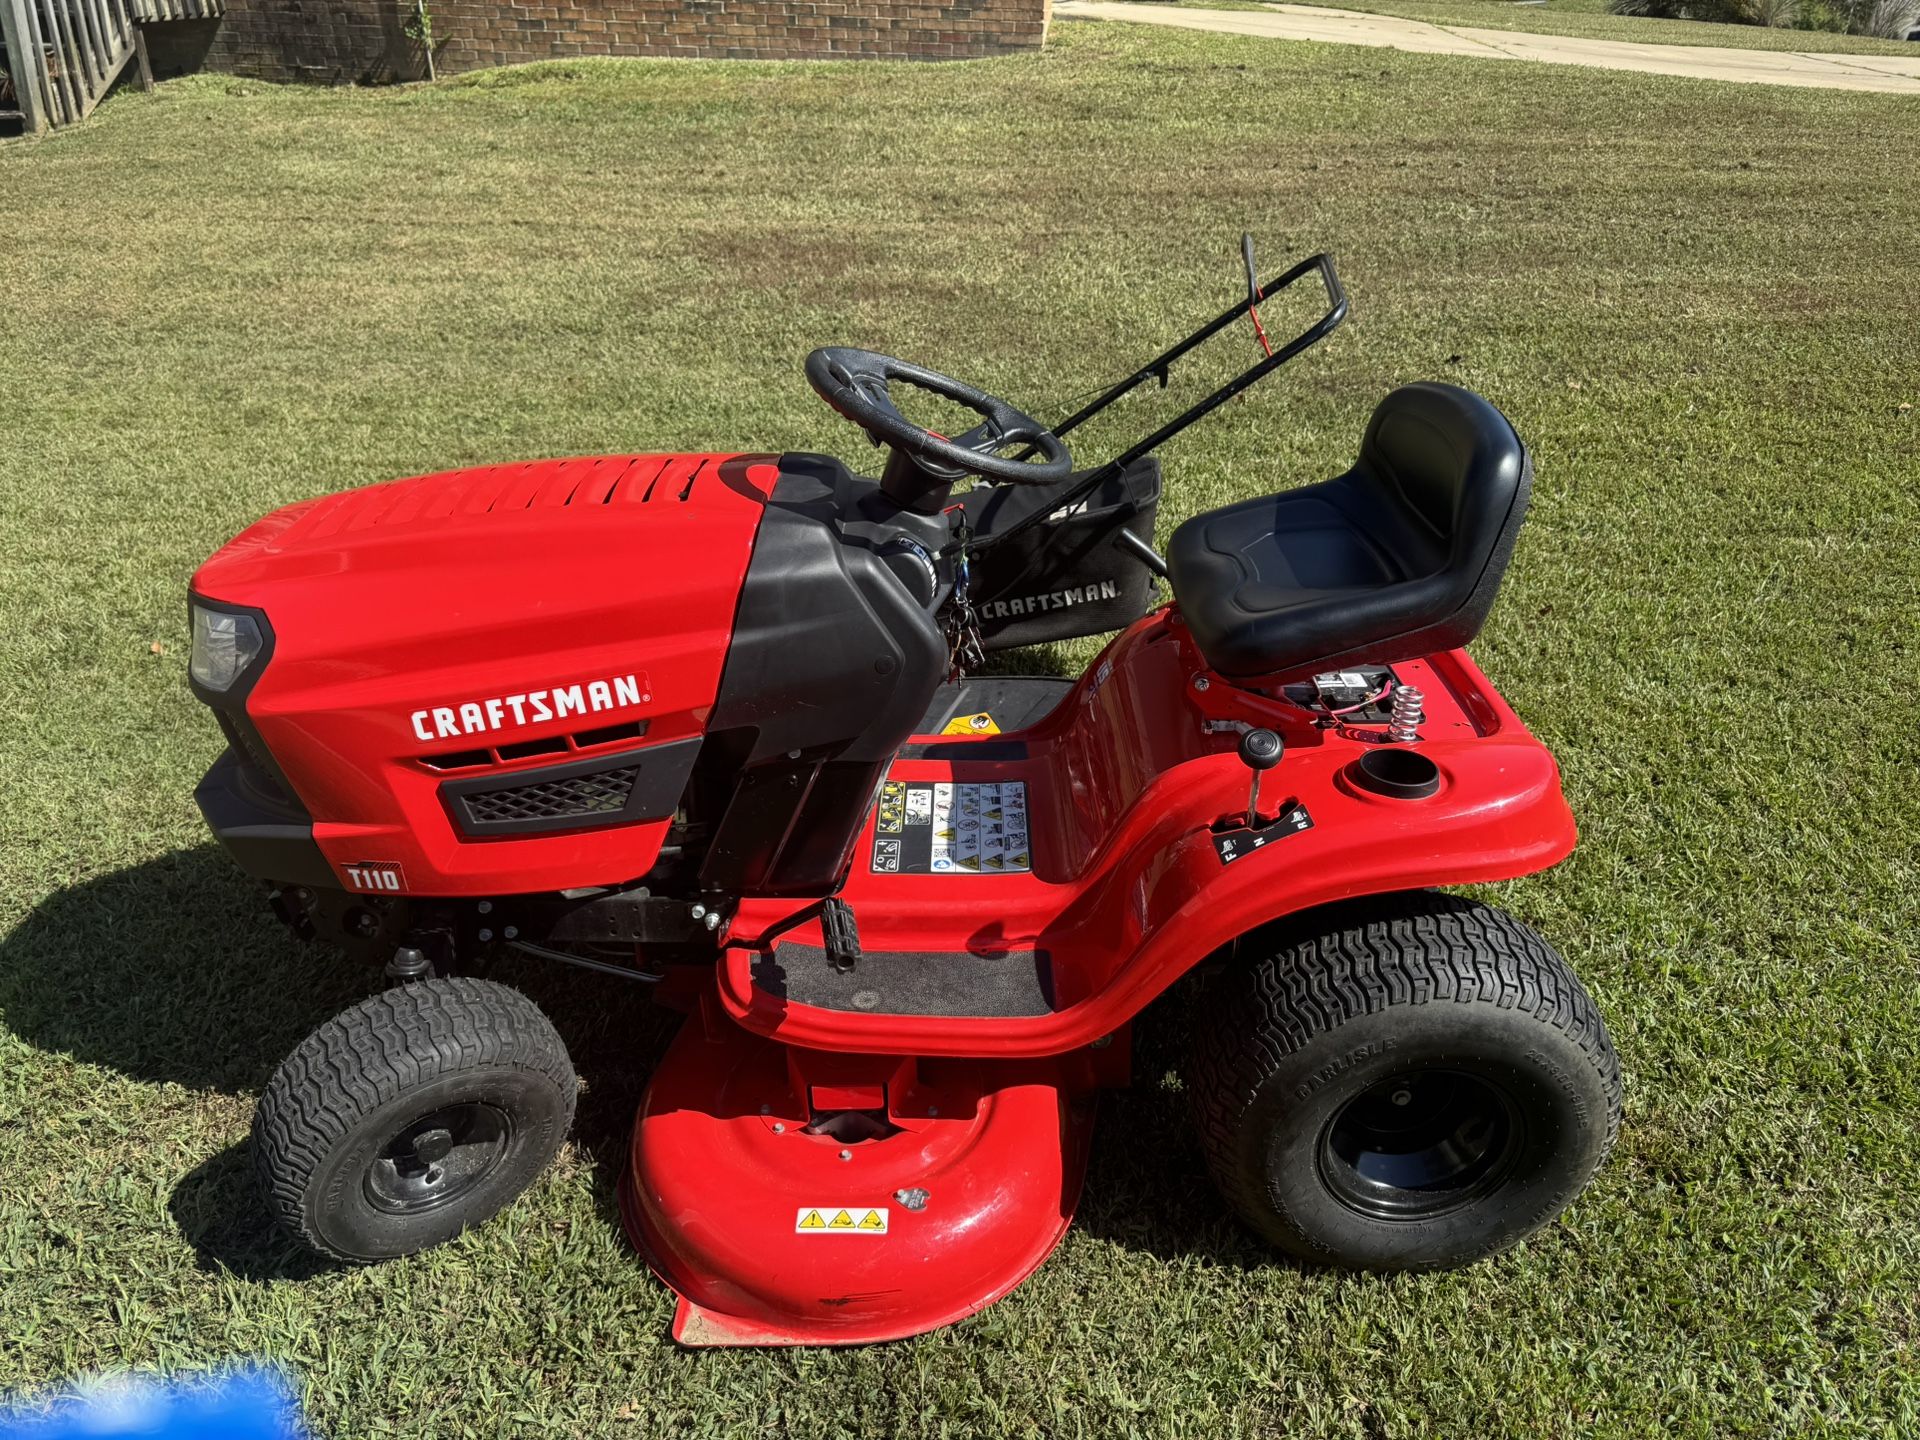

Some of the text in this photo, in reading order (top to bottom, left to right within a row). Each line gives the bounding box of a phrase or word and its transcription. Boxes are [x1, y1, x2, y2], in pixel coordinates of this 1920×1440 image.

[982, 580, 1117, 619] CRAFTSMAN
[411, 675, 641, 741] CRAFTSMAN
[1225, 821, 1308, 862] F N R
[347, 868, 400, 890] T110
[1295, 1036, 1397, 1101] CARLISLE
